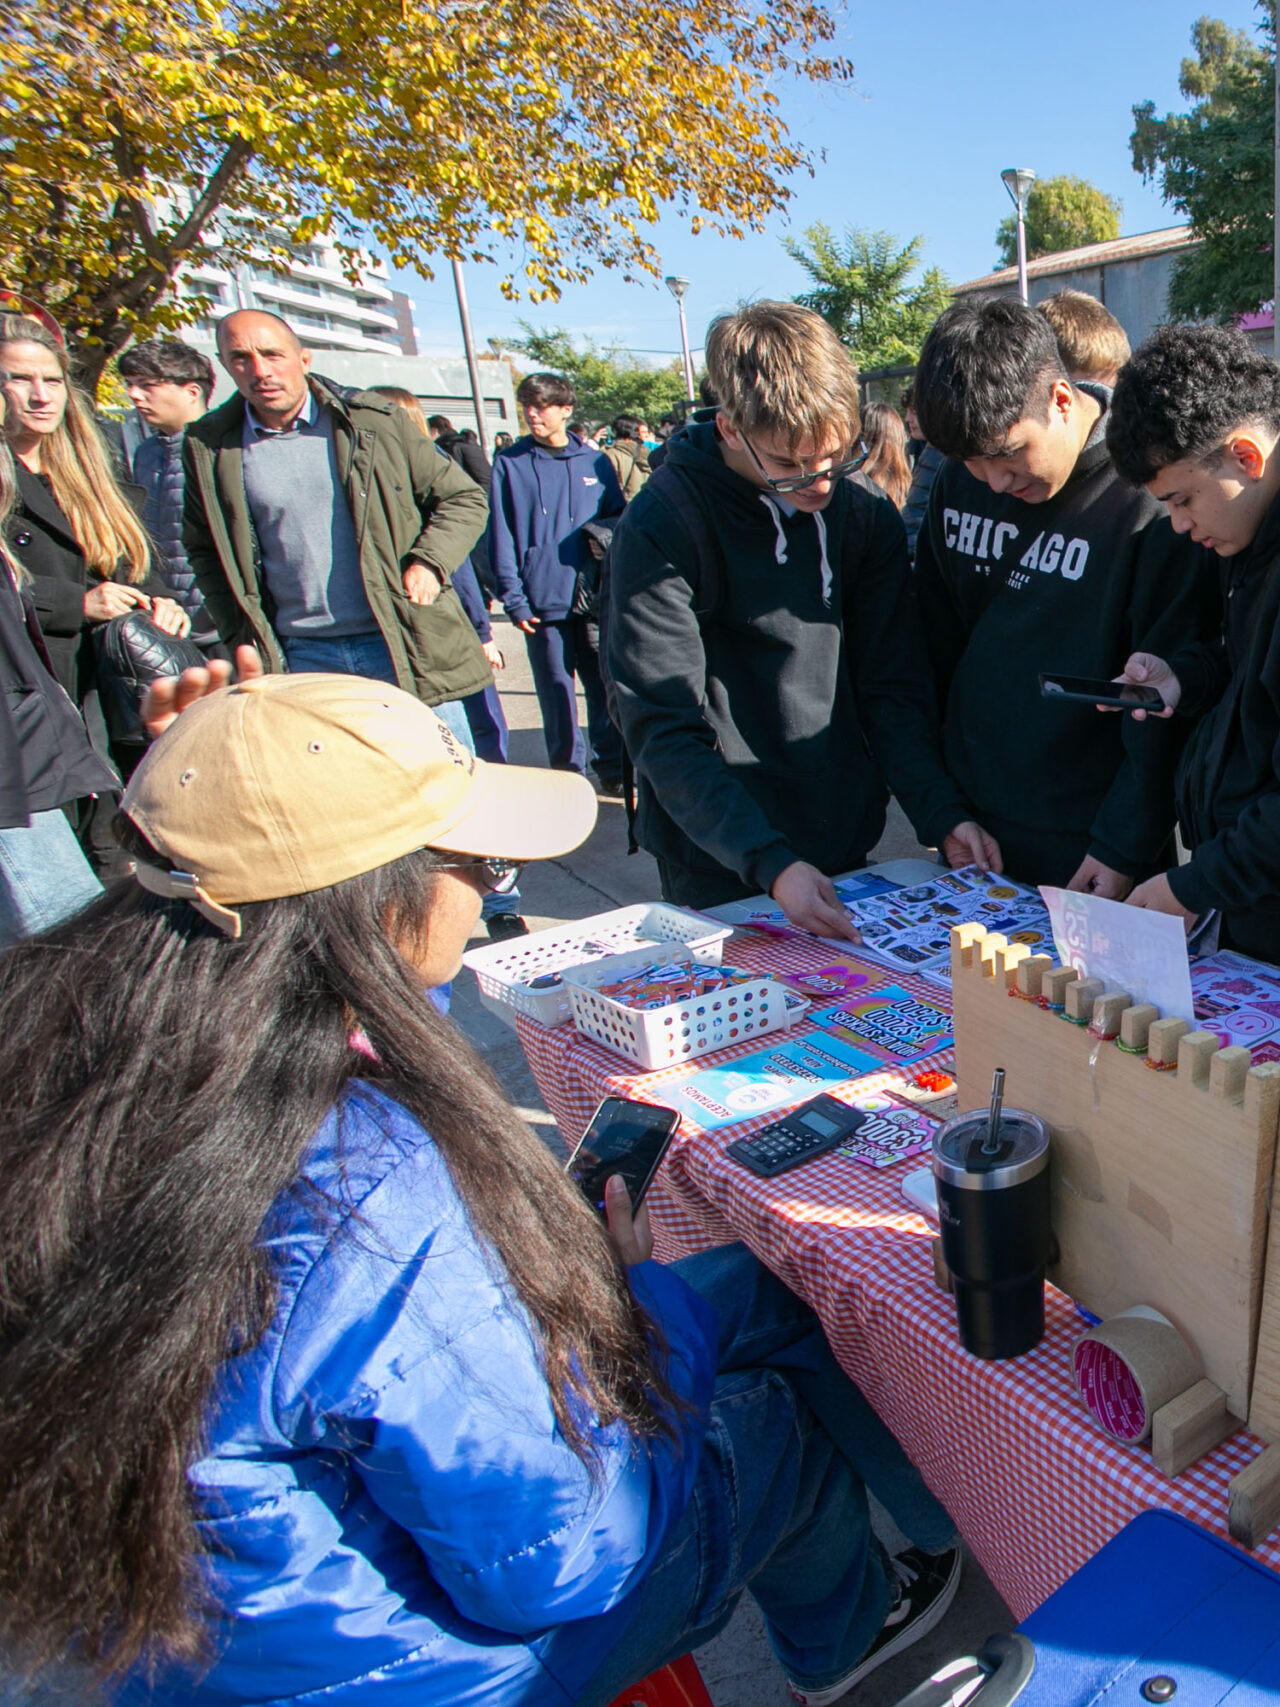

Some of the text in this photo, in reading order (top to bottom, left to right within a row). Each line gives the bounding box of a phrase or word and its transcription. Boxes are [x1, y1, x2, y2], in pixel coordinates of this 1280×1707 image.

[943, 507, 1090, 581] CHICAGO
[862, 1009, 922, 1037] $2000
[889, 998, 952, 1027] $2500
[828, 1011, 924, 1057] HOJA DE STICKERS
[681, 1086, 732, 1118] ACEPTAMOS
